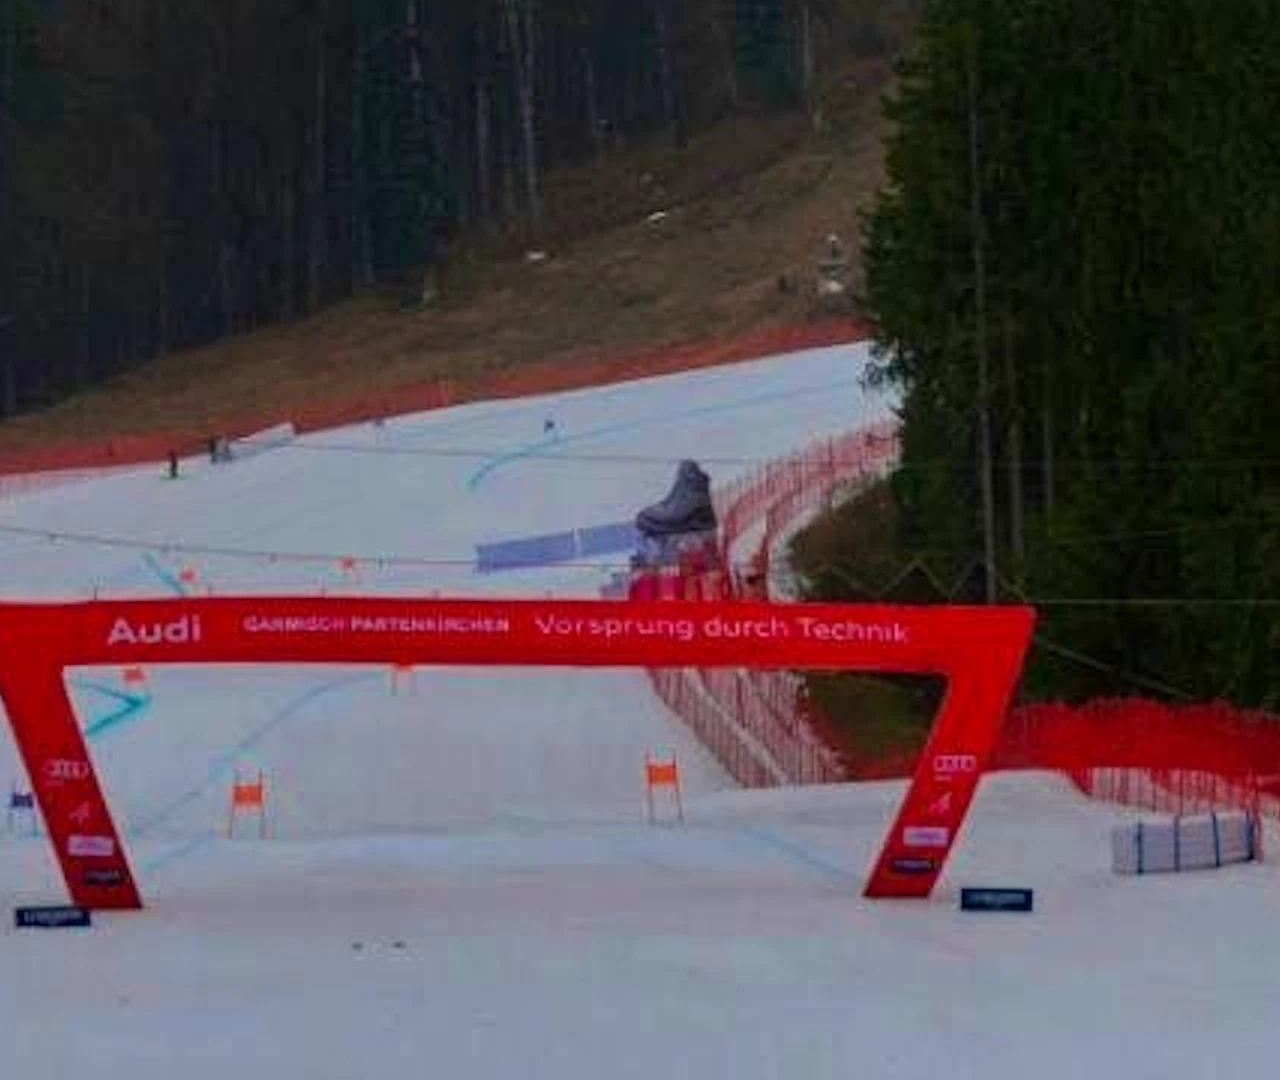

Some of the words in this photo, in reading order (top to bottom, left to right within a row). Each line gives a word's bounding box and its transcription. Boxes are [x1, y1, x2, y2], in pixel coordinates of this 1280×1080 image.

[107, 614, 202, 646] Audi
[534, 614, 695, 641] Vorsprung
[703, 617, 790, 638] durch
[795, 617, 910, 644] Technik
